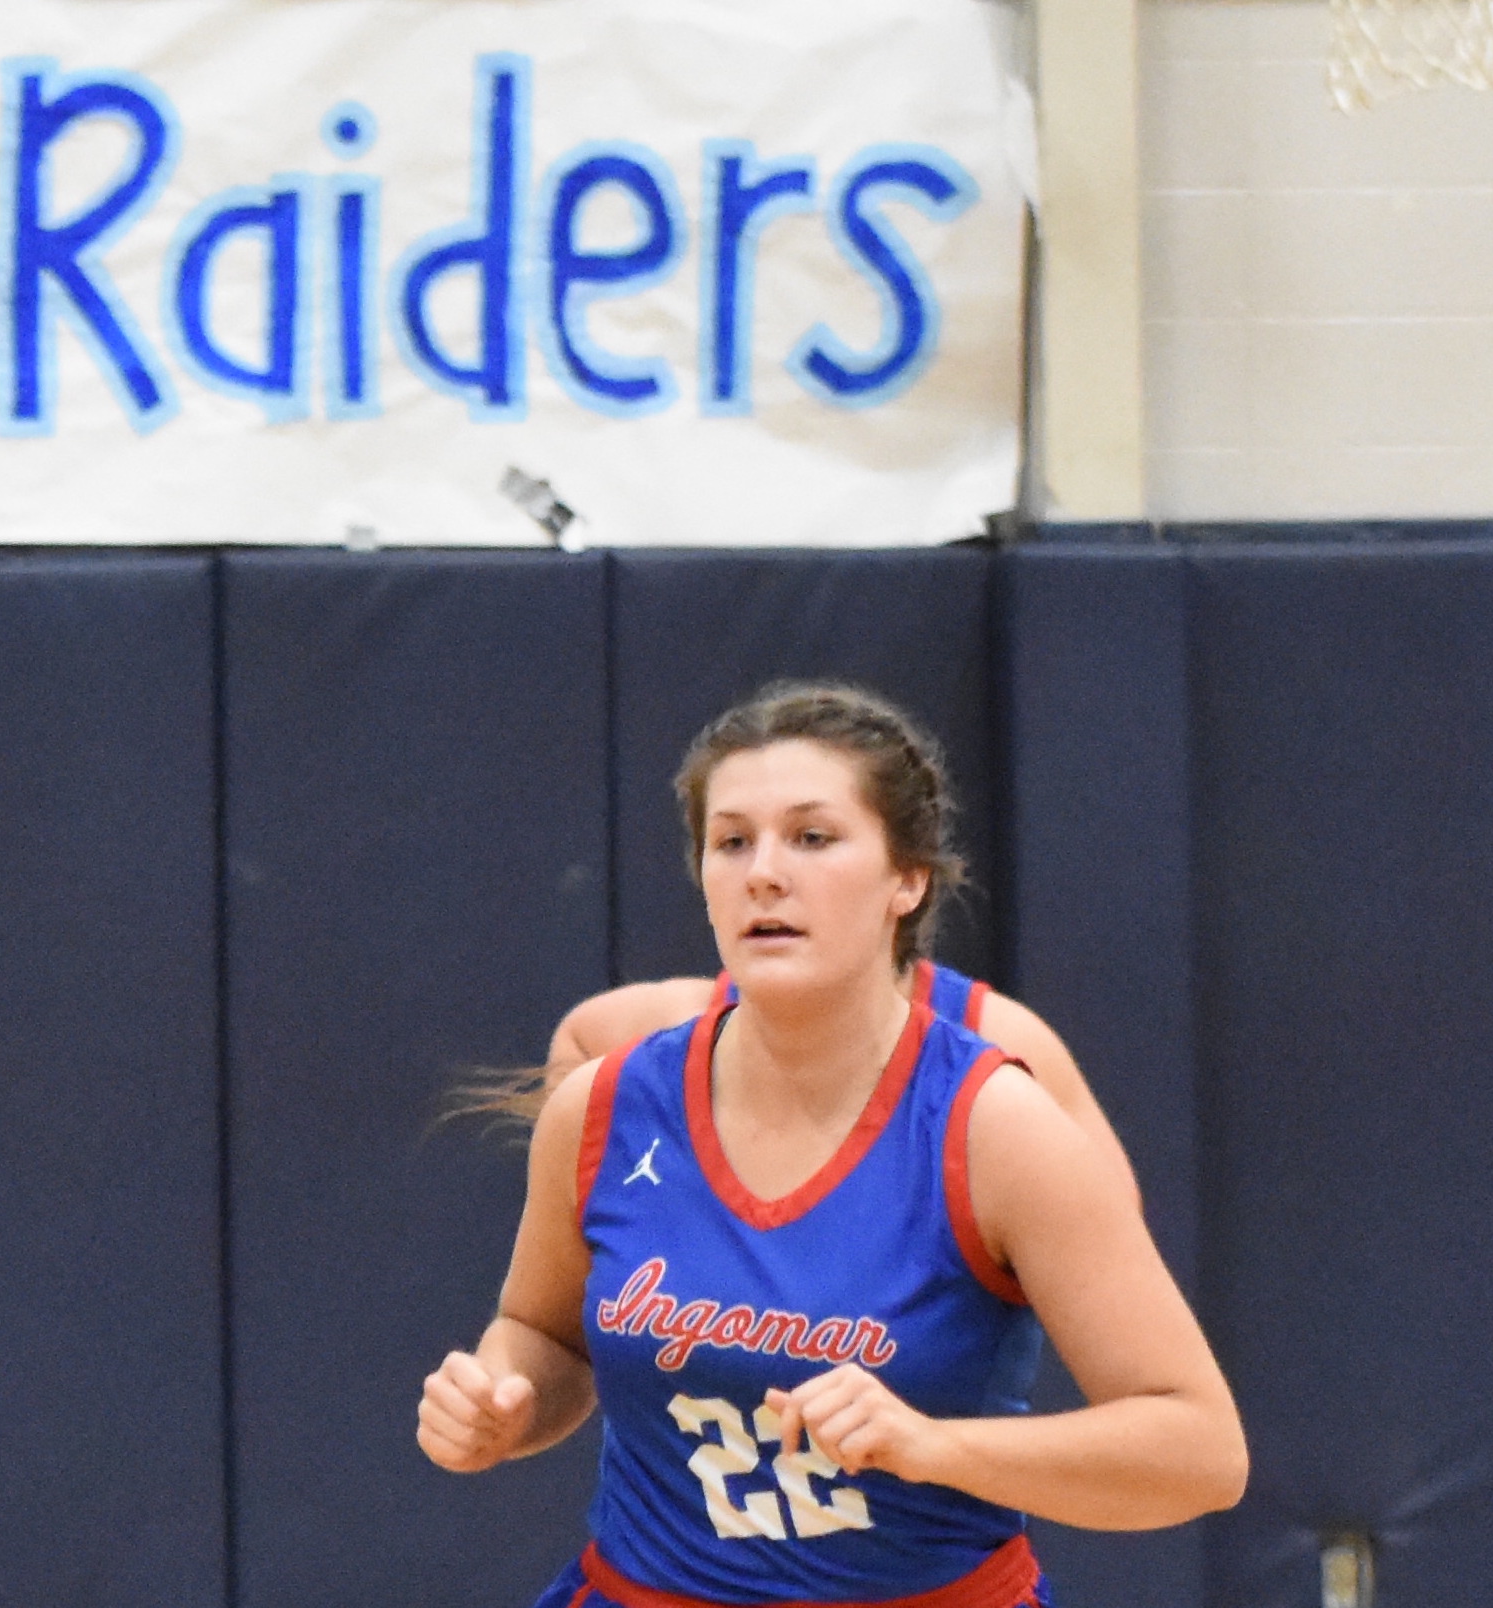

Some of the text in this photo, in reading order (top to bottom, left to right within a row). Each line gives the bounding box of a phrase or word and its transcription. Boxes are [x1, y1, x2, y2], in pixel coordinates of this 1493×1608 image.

[0, 52, 980, 436] Raiders
[597, 1257, 898, 1371] Ingomar
[666, 1393, 875, 1541] 22
